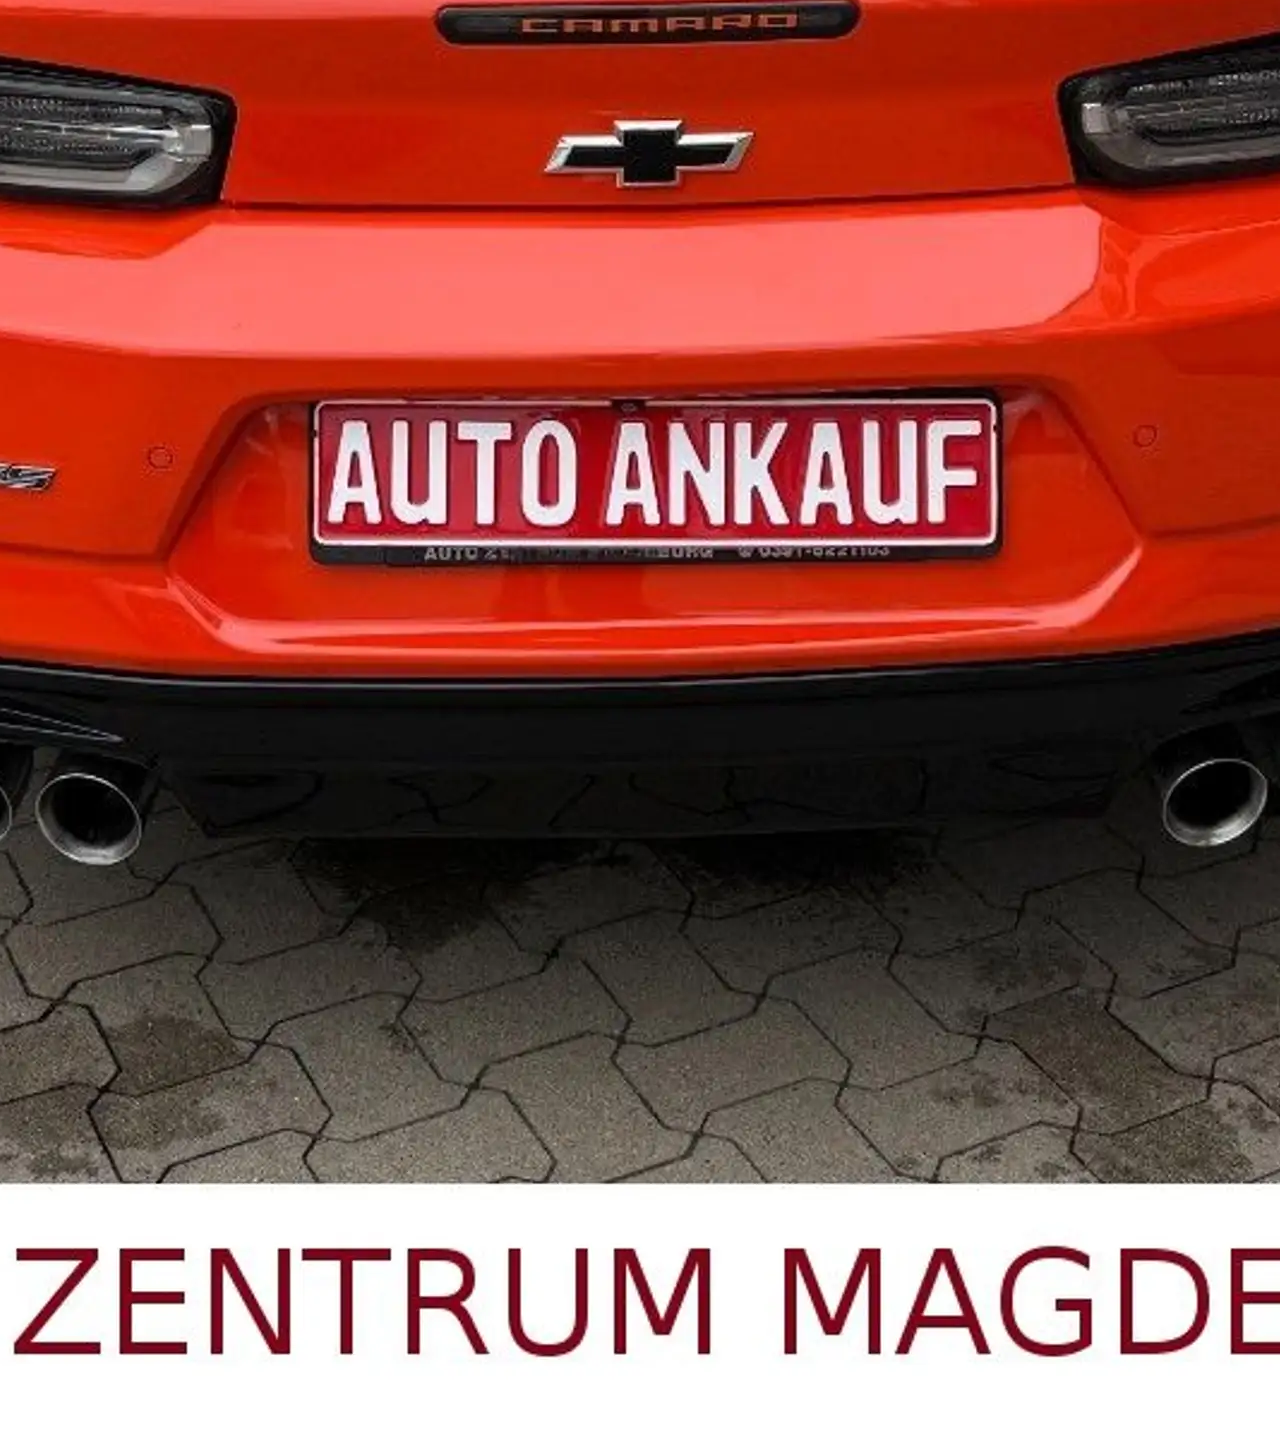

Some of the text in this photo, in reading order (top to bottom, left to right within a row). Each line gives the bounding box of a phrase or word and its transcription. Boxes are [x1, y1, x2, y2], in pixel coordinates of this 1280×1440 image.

[522, 12, 798, 34] CAMARO
[326, 420, 983, 526] AUTO ANKAUF
